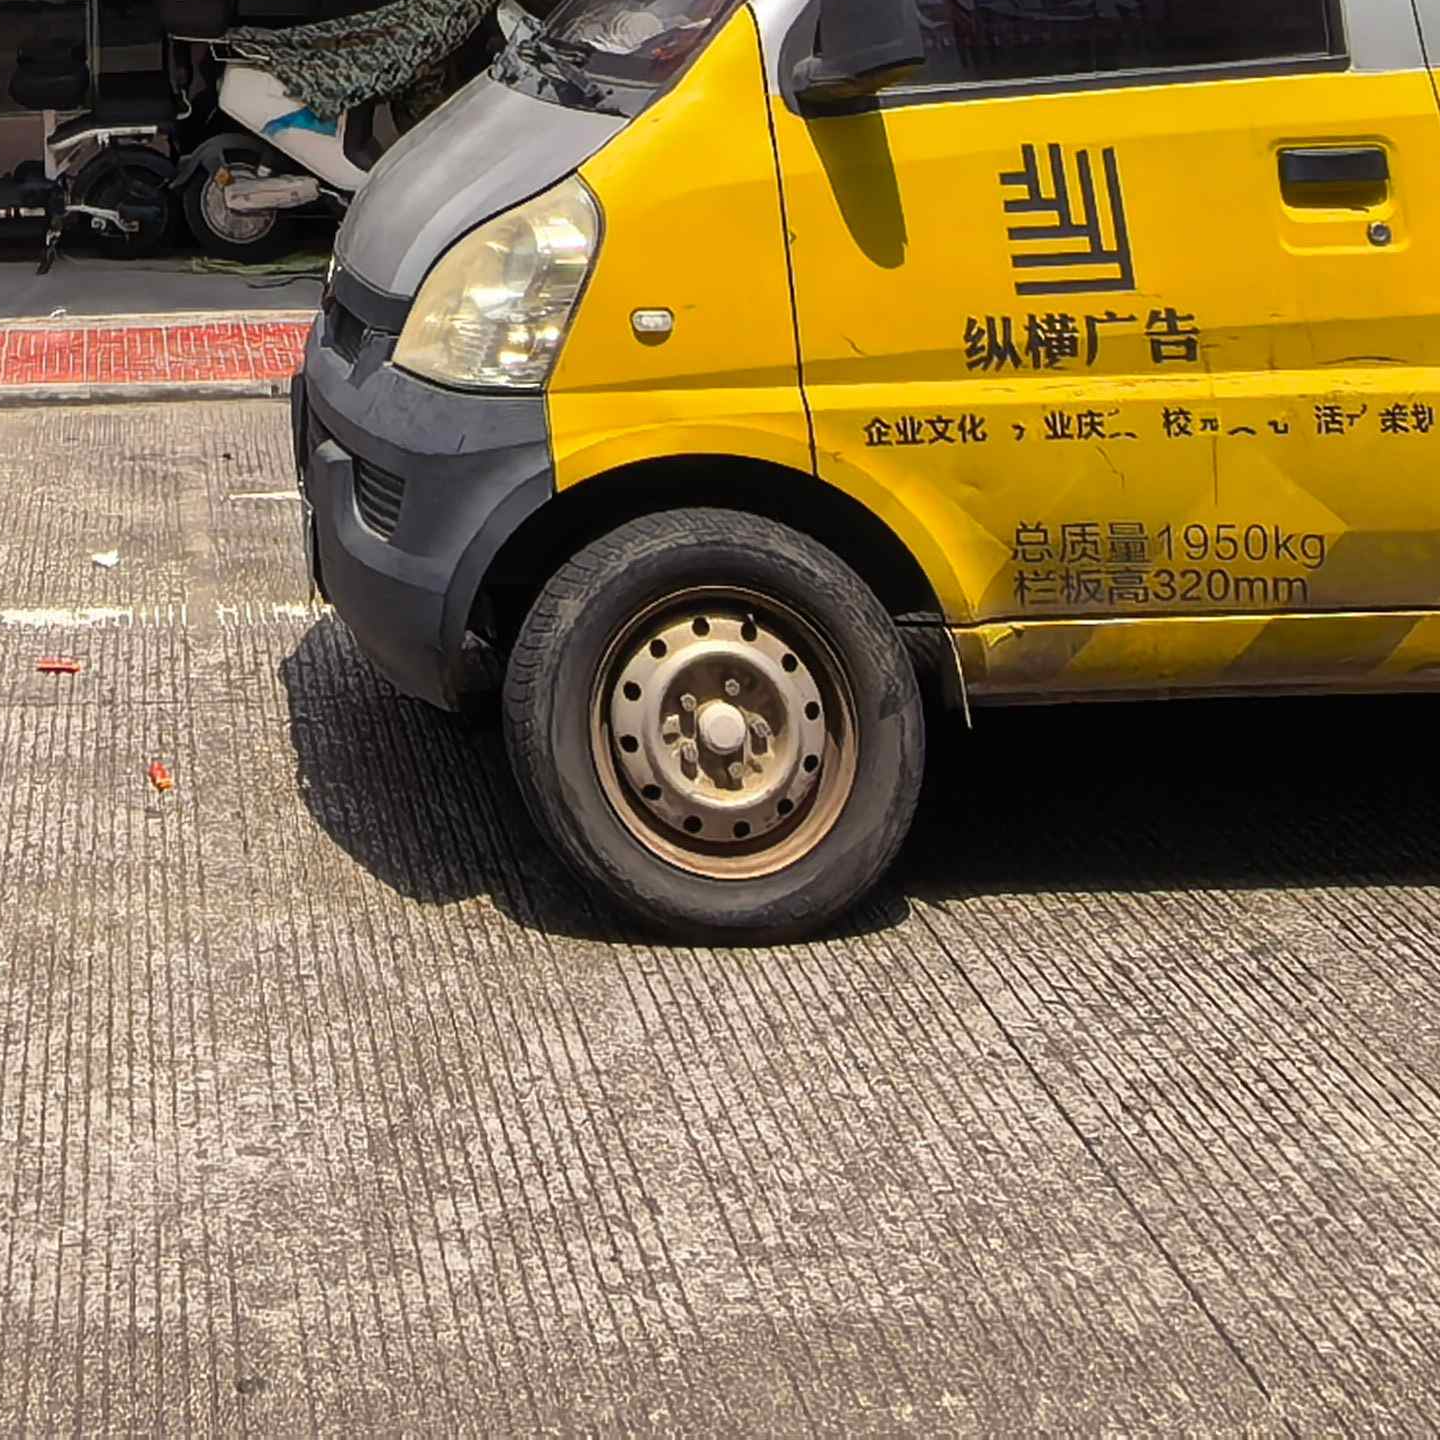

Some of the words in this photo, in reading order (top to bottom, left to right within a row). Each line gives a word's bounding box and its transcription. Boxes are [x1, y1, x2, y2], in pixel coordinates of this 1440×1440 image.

[963, 308, 1201, 372] 纵横广告
[863, 413, 988, 448] 企业文化
[1011, 520, 1326, 569] 总质量1950kg
[1012, 566, 1310, 607] 栏板高320mm
